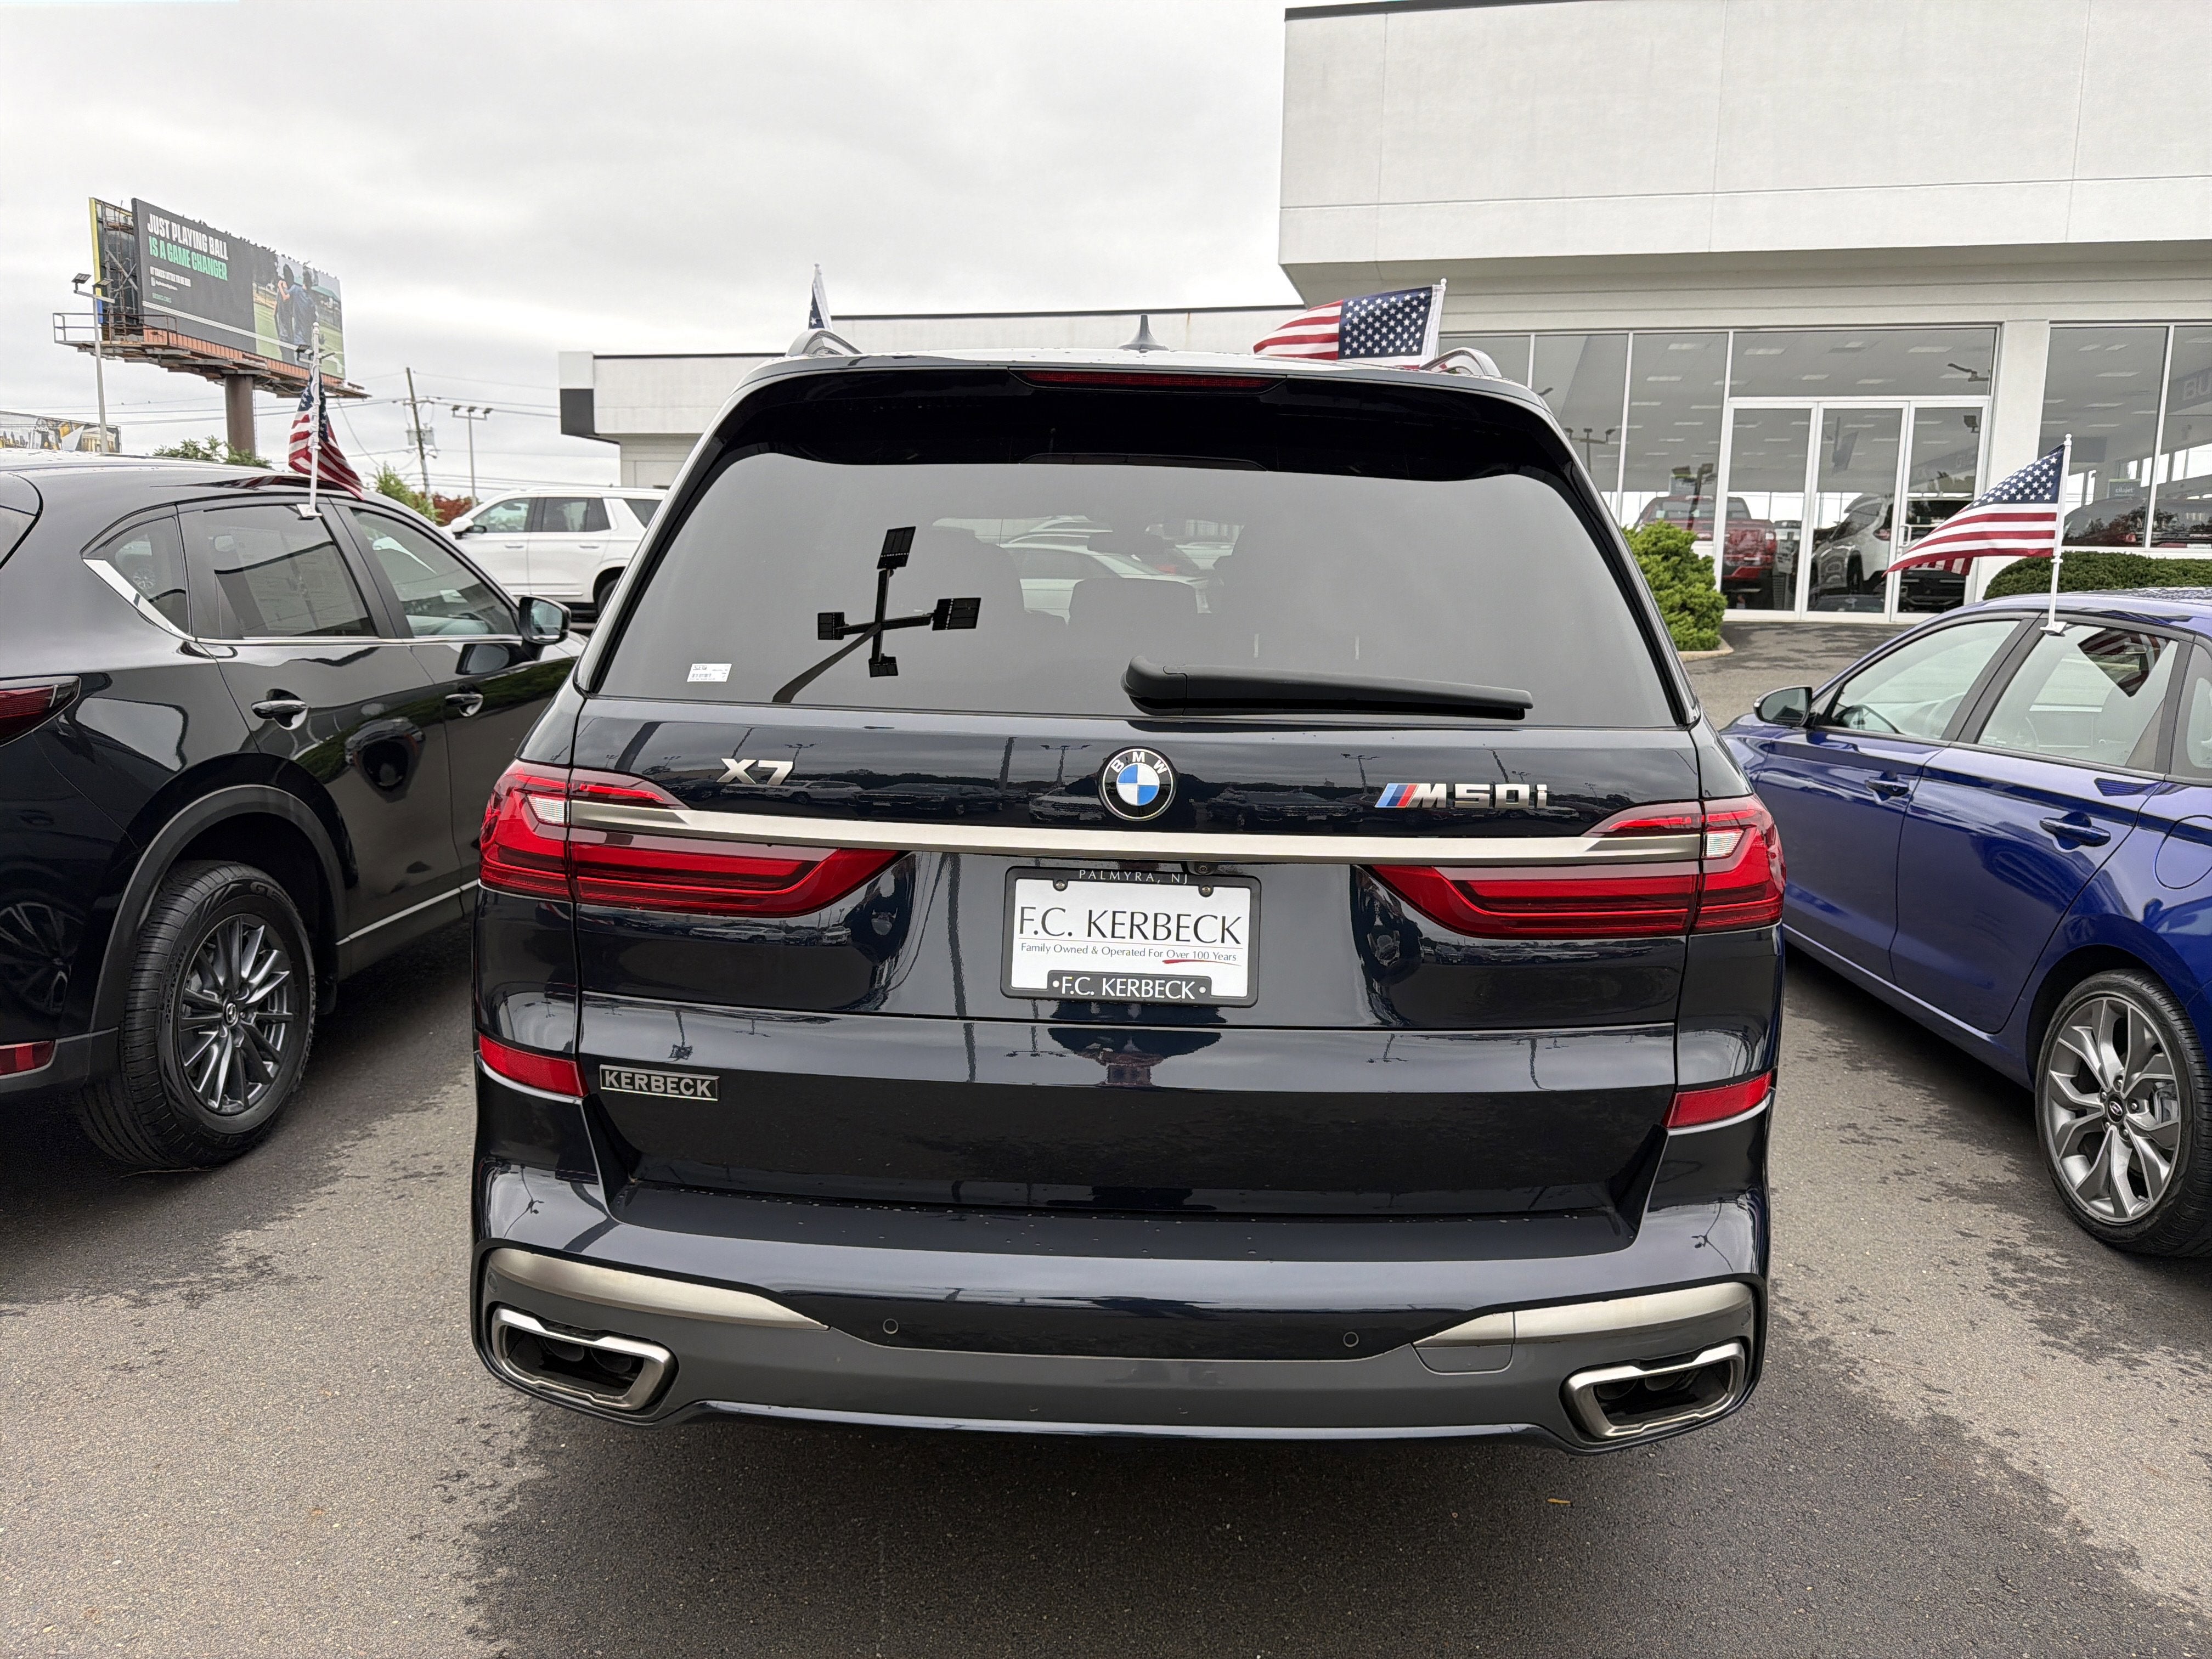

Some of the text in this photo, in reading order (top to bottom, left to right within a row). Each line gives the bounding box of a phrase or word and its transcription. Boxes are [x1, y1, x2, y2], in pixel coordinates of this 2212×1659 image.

[147, 213, 229, 261] JUST PLAYING BALL
[148, 235, 228, 281] IS A GAME CHANGER
[716, 758, 794, 786] X7
[1110, 752, 1167, 774] BMW
[1404, 783, 1547, 809] M50i
[1079, 870, 1188, 884] PALMYRA, NJ
[1019, 906, 1242, 945] F.C. KERBECK
[1021, 943, 1237, 961] Family Owned & Operated For Over 100 Years
[1062, 976, 1195, 1000] F.C. KERBECK
[605, 1070, 712, 1097] KERBECK
